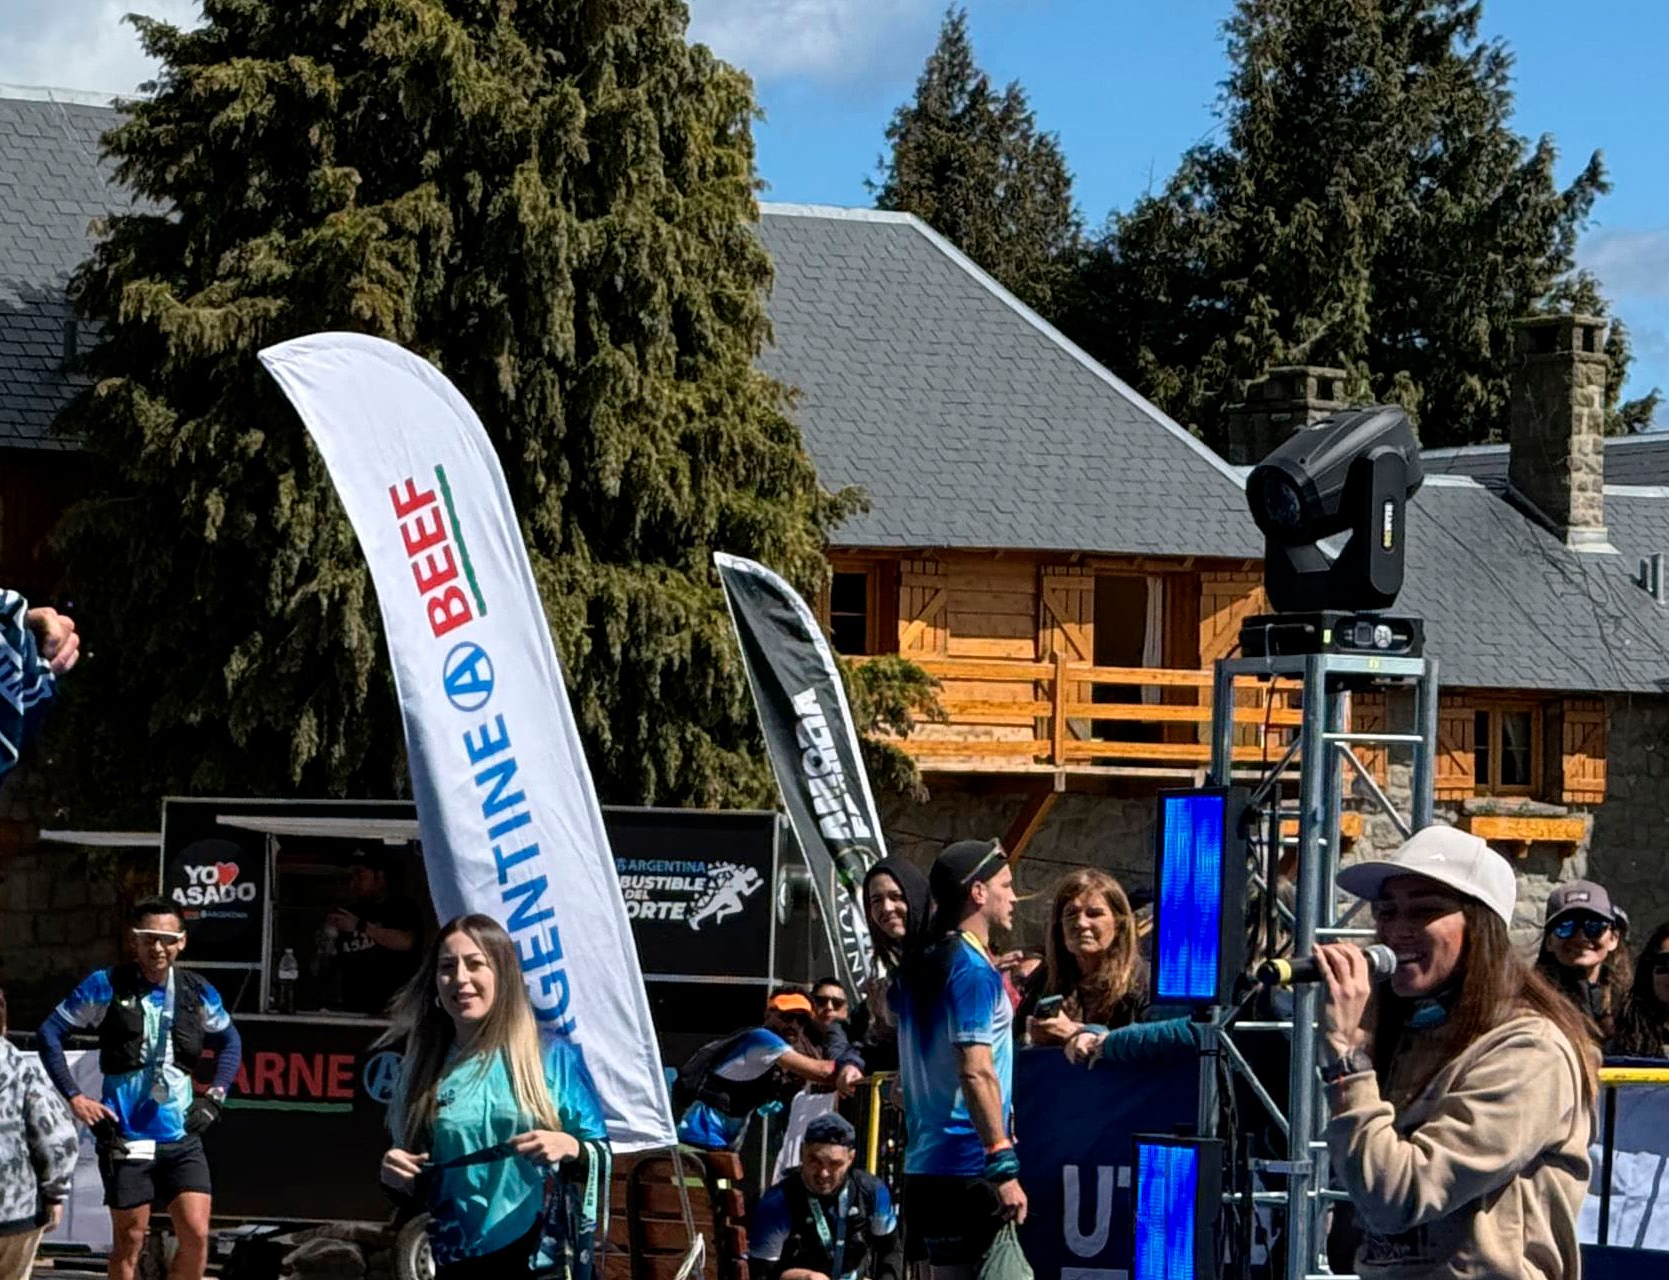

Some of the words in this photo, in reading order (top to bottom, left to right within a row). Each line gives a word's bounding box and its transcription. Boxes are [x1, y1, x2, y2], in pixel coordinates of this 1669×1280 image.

[389, 477, 473, 638] BEEF
[184, 865, 219, 884] YO
[627, 861, 706, 873] ARGENTINA
[172, 882, 256, 906] ASADO
[625, 890, 650, 900] DEL
